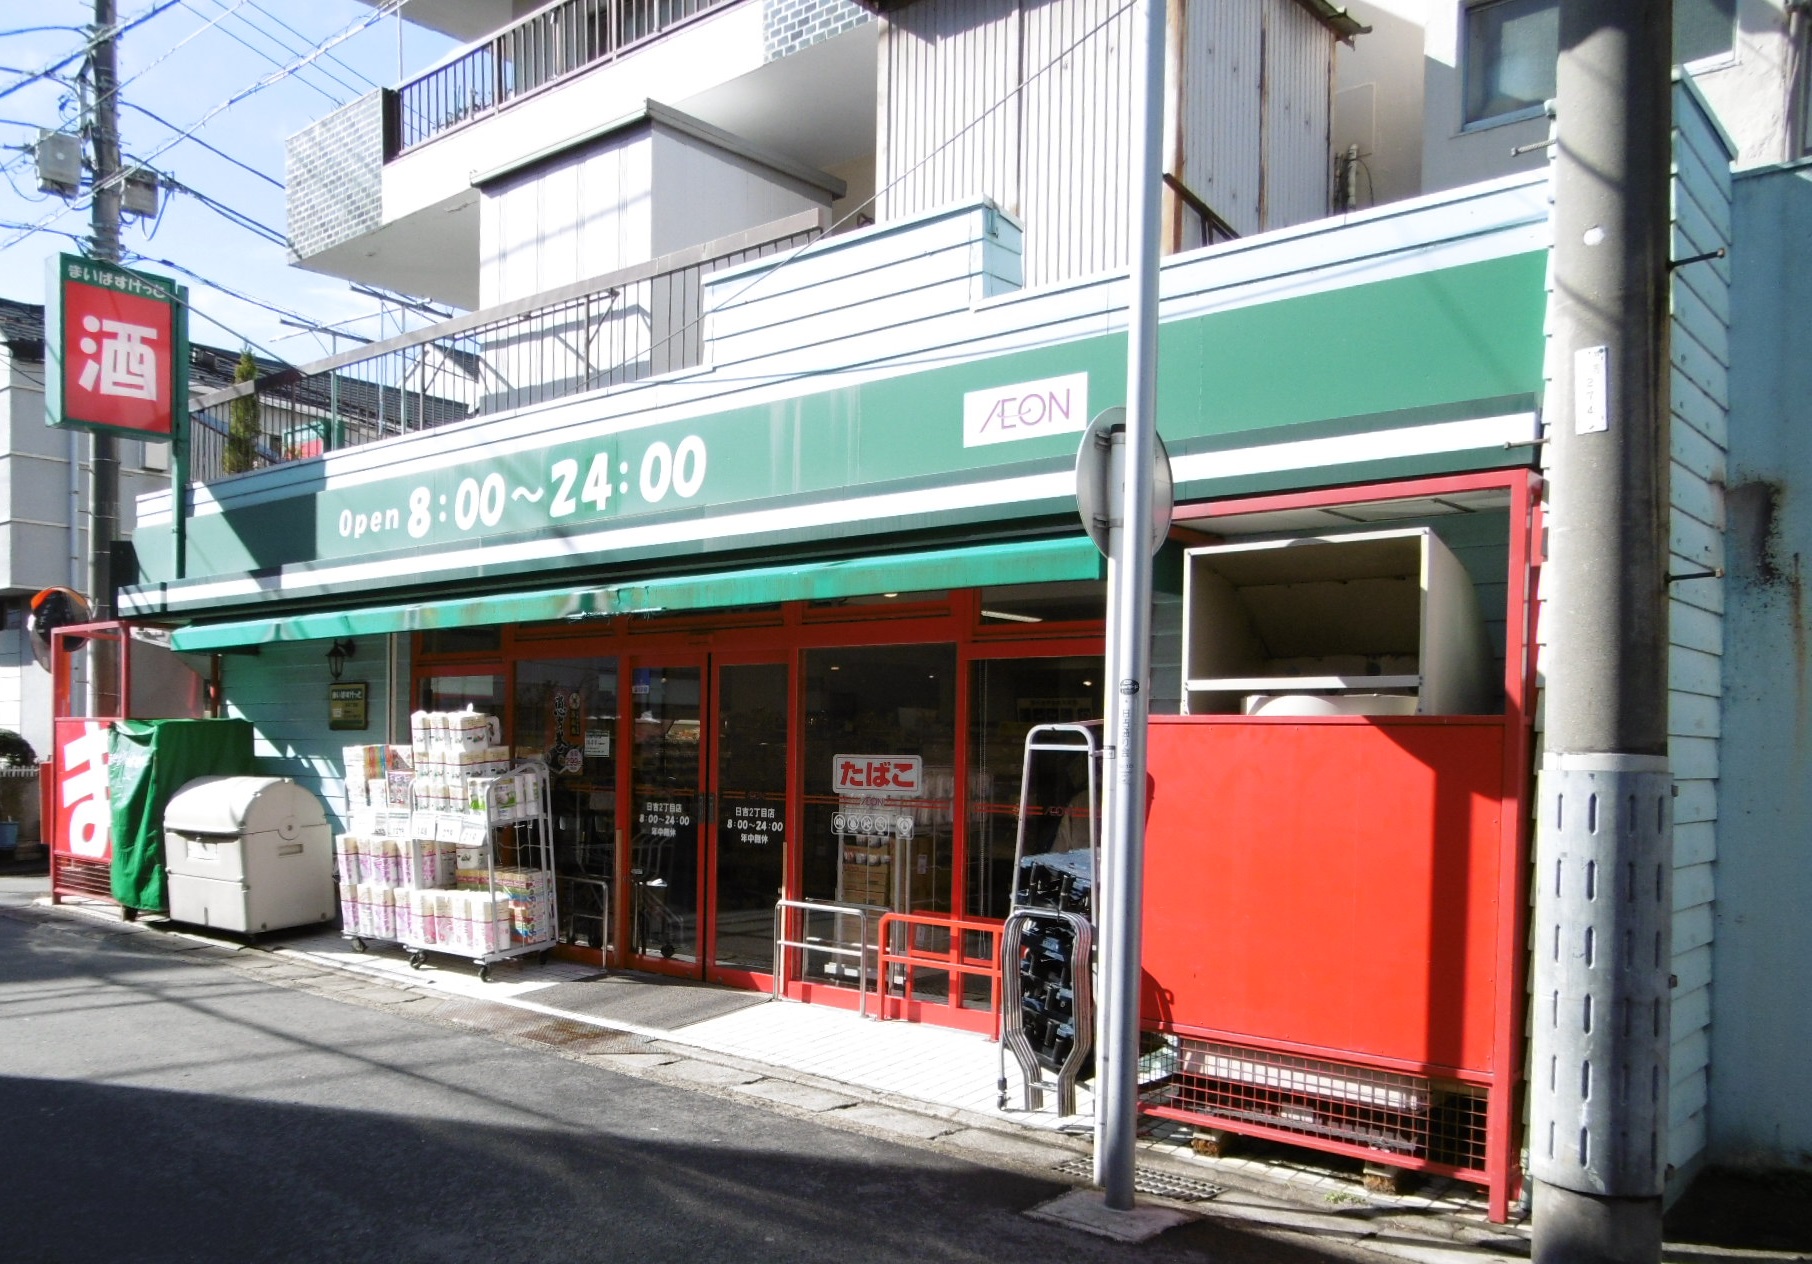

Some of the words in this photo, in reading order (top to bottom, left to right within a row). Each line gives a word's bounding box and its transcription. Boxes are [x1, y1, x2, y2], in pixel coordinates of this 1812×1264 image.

[67, 263, 167, 299] まいばすけっと
[77, 314, 158, 402] 酒
[338, 506, 400, 539] Open
[839, 761, 914, 788] たばこ
[646, 801, 682, 813] 日吉2丁目店
[735, 806, 775, 819] 日吉2丁目店
[740, 833, 769, 845] 年中無休
